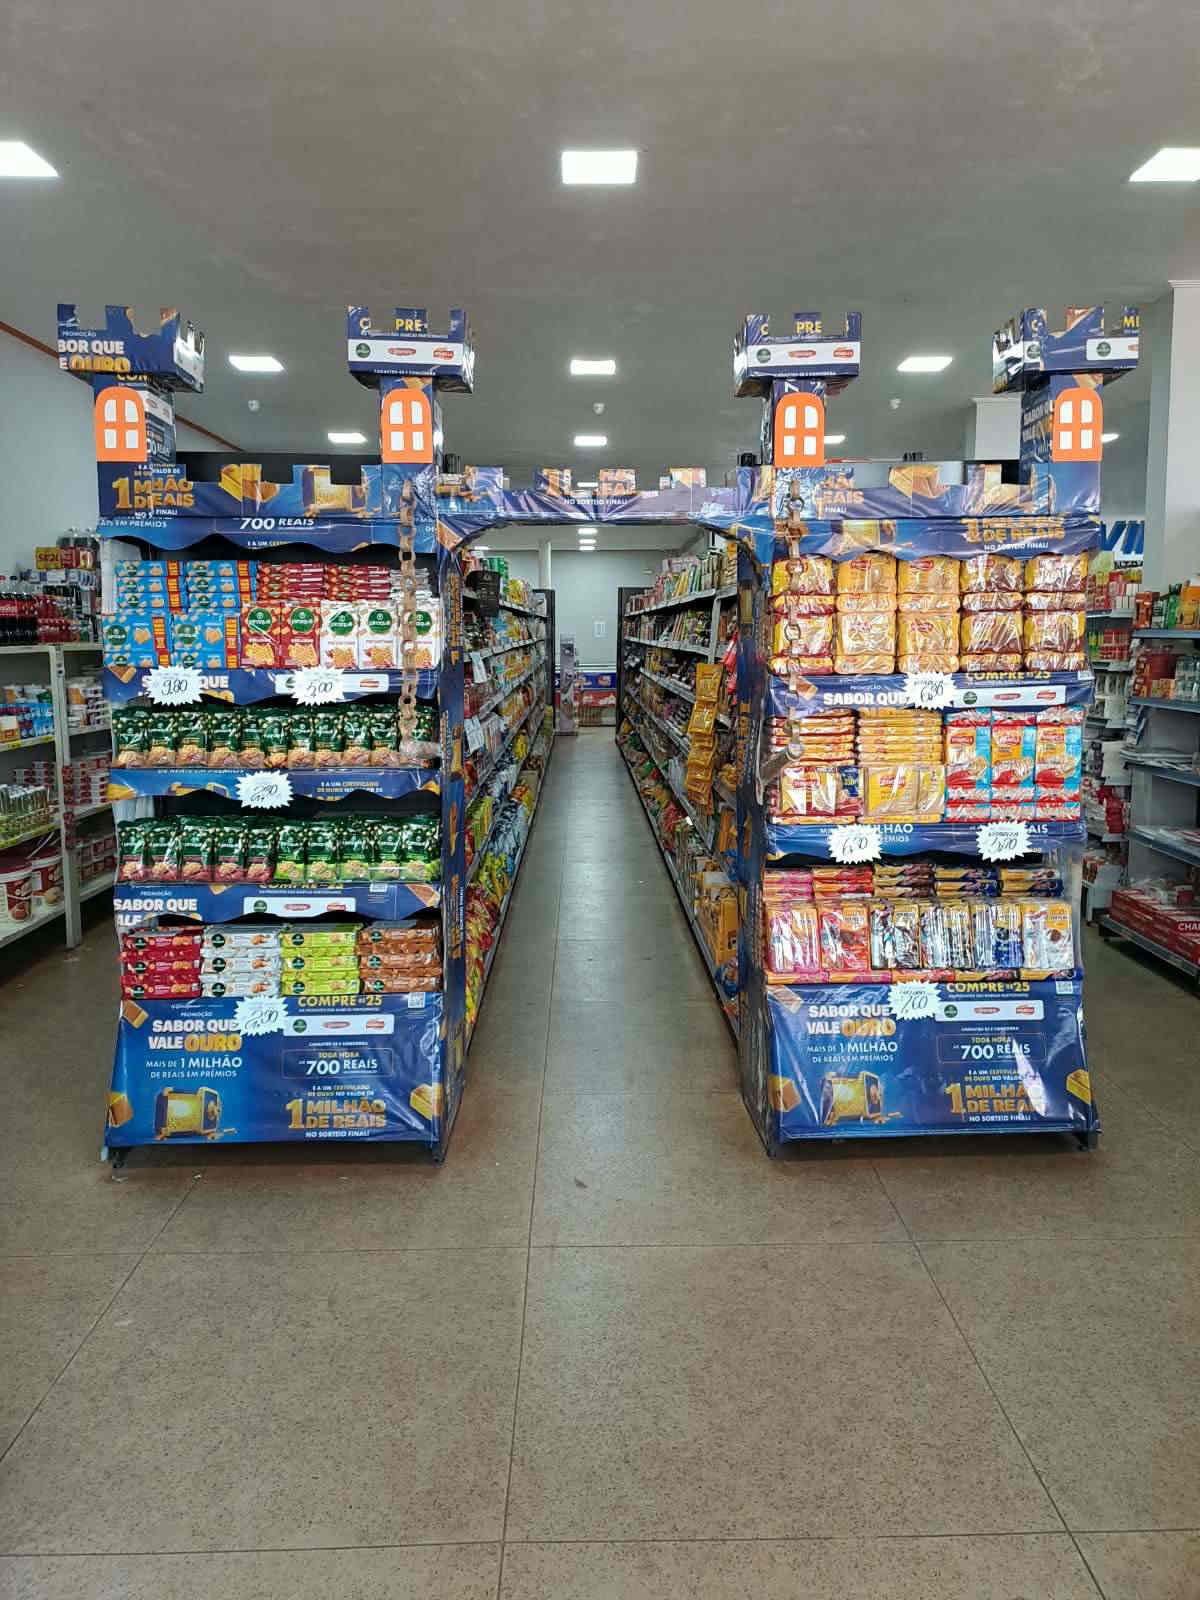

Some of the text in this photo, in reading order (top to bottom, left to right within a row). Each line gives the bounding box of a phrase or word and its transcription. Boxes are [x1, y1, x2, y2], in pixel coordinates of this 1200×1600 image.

[91, 340, 125, 355] QUE
[112, 476, 133, 510] 1
[239, 517, 315, 531] 700 REAIS
[822, 692, 874, 706] SABOR
[113, 898, 199, 914] SABOR QUE
[946, 981, 1005, 993] COMPRE
[1015, 981, 1030, 993] 25
[297, 995, 357, 1008] COMPRE
[366, 995, 383, 1007] 25
[808, 1004, 891, 1018] SABOR QUE
[152, 1019, 240, 1034] SABOR QUE
[806, 1018, 896, 1037] VALE OURO
[148, 1033, 243, 1053] VALE OURO
[847, 1039, 898, 1053] MILHÃO
[860, 1054, 894, 1062] PRÊMIOS
[961, 1043, 1031, 1060] 700 REAIS
[146, 1055, 243, 1069] MAIS DE 1 MILHÃO
[305, 1059, 340, 1076] 700
[343, 1059, 378, 1070] REAIS
[150, 1071, 162, 1079] DE
[162, 1071, 185, 1079] REAIS
[200, 1069, 238, 1078] PRÊMIOS
[945, 1082, 964, 1115] 1
[286, 1096, 387, 1130] 1 MILHÃO
[966, 1100, 991, 1113] DE
[305, 1113, 388, 1129] DE REAIS
[305, 1129, 370, 1138] NO SORTEIO FINAL!
